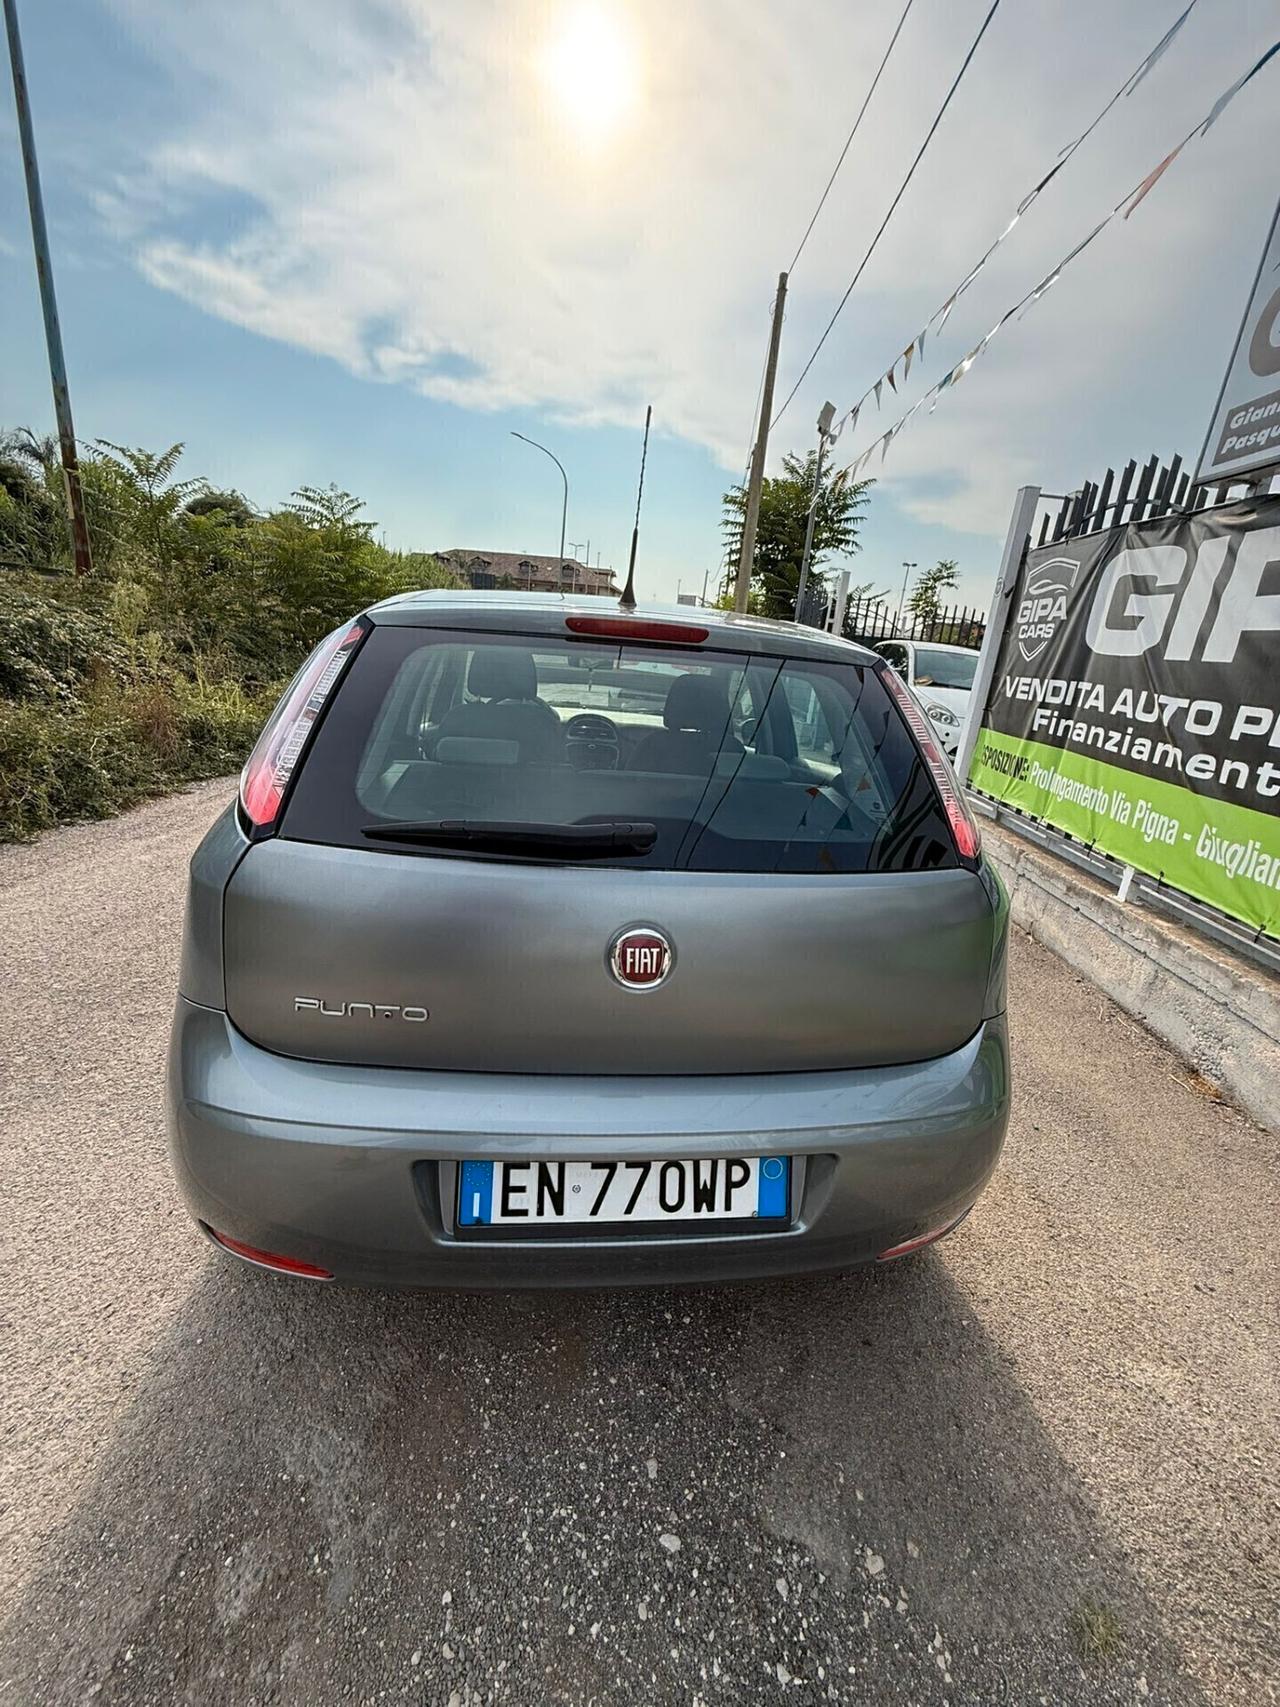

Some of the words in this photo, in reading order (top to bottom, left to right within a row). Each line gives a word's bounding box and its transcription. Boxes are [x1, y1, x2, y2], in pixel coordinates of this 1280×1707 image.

[1017, 595, 1068, 623] GIPA
[1018, 623, 1055, 639] CARS
[1006, 675, 1105, 713] VENDITA
[1109, 688, 1223, 736] AUTO
[1032, 708, 1280, 797] Finanziament
[1109, 790, 1132, 826] Via
[1131, 799, 1180, 843] Pigna
[626, 947, 661, 974] FIAT
[294, 997, 430, 1022] PUNTO
[500, 1160, 566, 1218] EN
